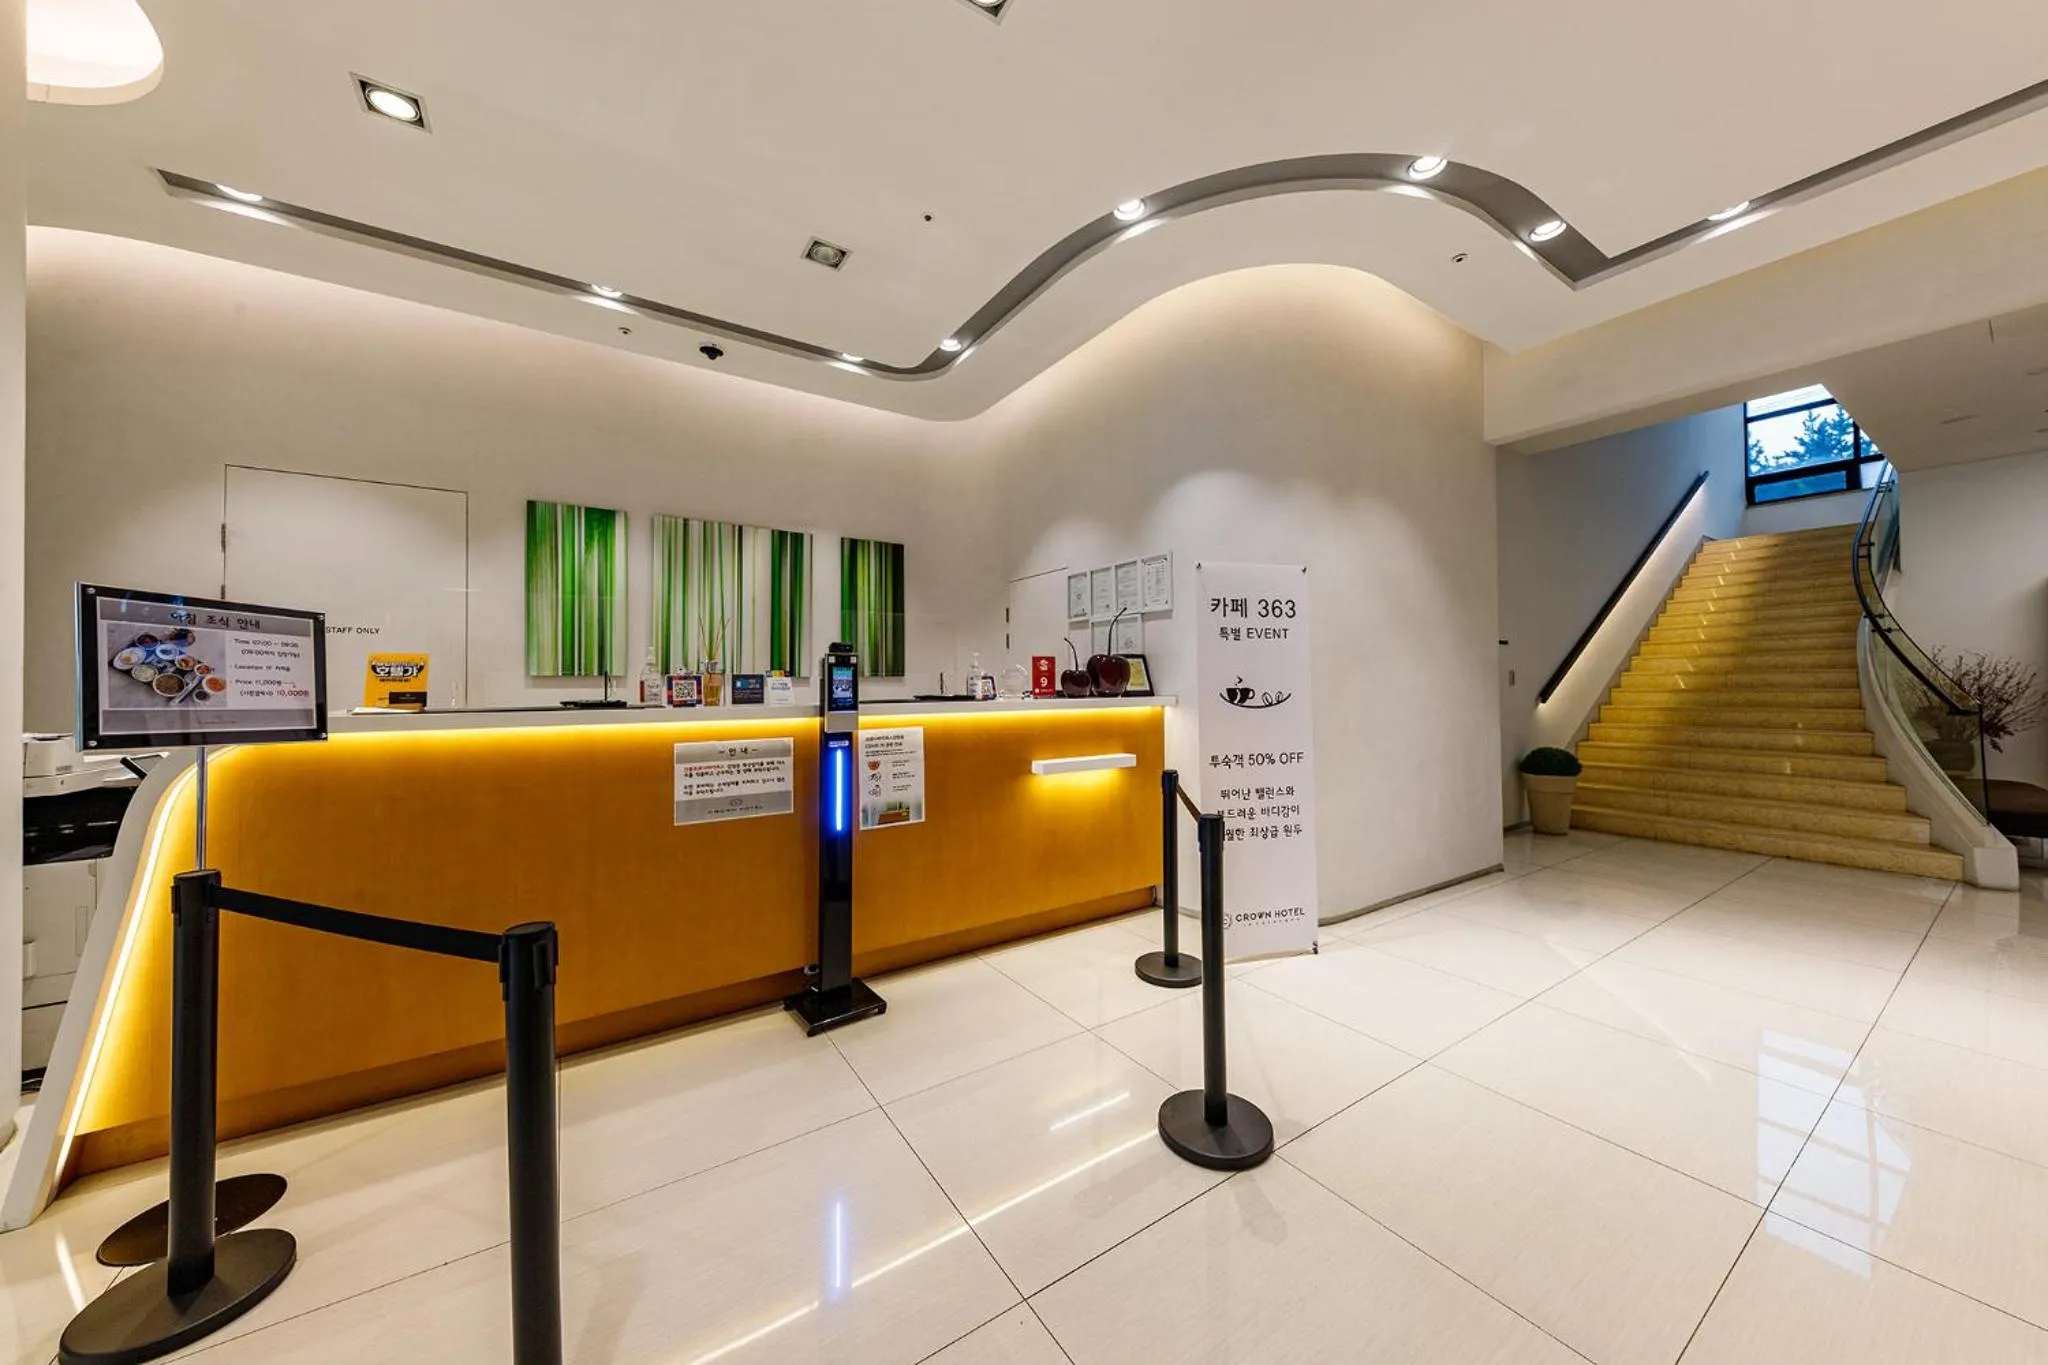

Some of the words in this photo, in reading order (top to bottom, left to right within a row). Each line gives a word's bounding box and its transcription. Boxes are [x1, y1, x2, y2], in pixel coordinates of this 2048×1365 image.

[1210, 597, 1248, 618] 카페
[1258, 598, 1296, 619] 363
[207, 615, 230, 628] 조식
[237, 616, 260, 630] 안내
[1219, 627, 1241, 641] 특별
[1246, 627, 1289, 640] EVENT
[1040, 676, 1048, 687] 9
[1209, 753, 1244, 769] 투숙객
[1248, 752, 1276, 766] 50%
[1279, 751, 1304, 765] OFF
[1220, 787, 1251, 800] 뛰어난
[1255, 785, 1295, 800] 밸런스와
[1261, 804, 1300, 818] 바디감이
[1224, 827, 1245, 841] 월한
[1250, 825, 1279, 840] 최상급
[1283, 823, 1303, 837] 원두
[1235, 910, 1272, 922] CROWN
[1274, 907, 1305, 918] HOTEL
